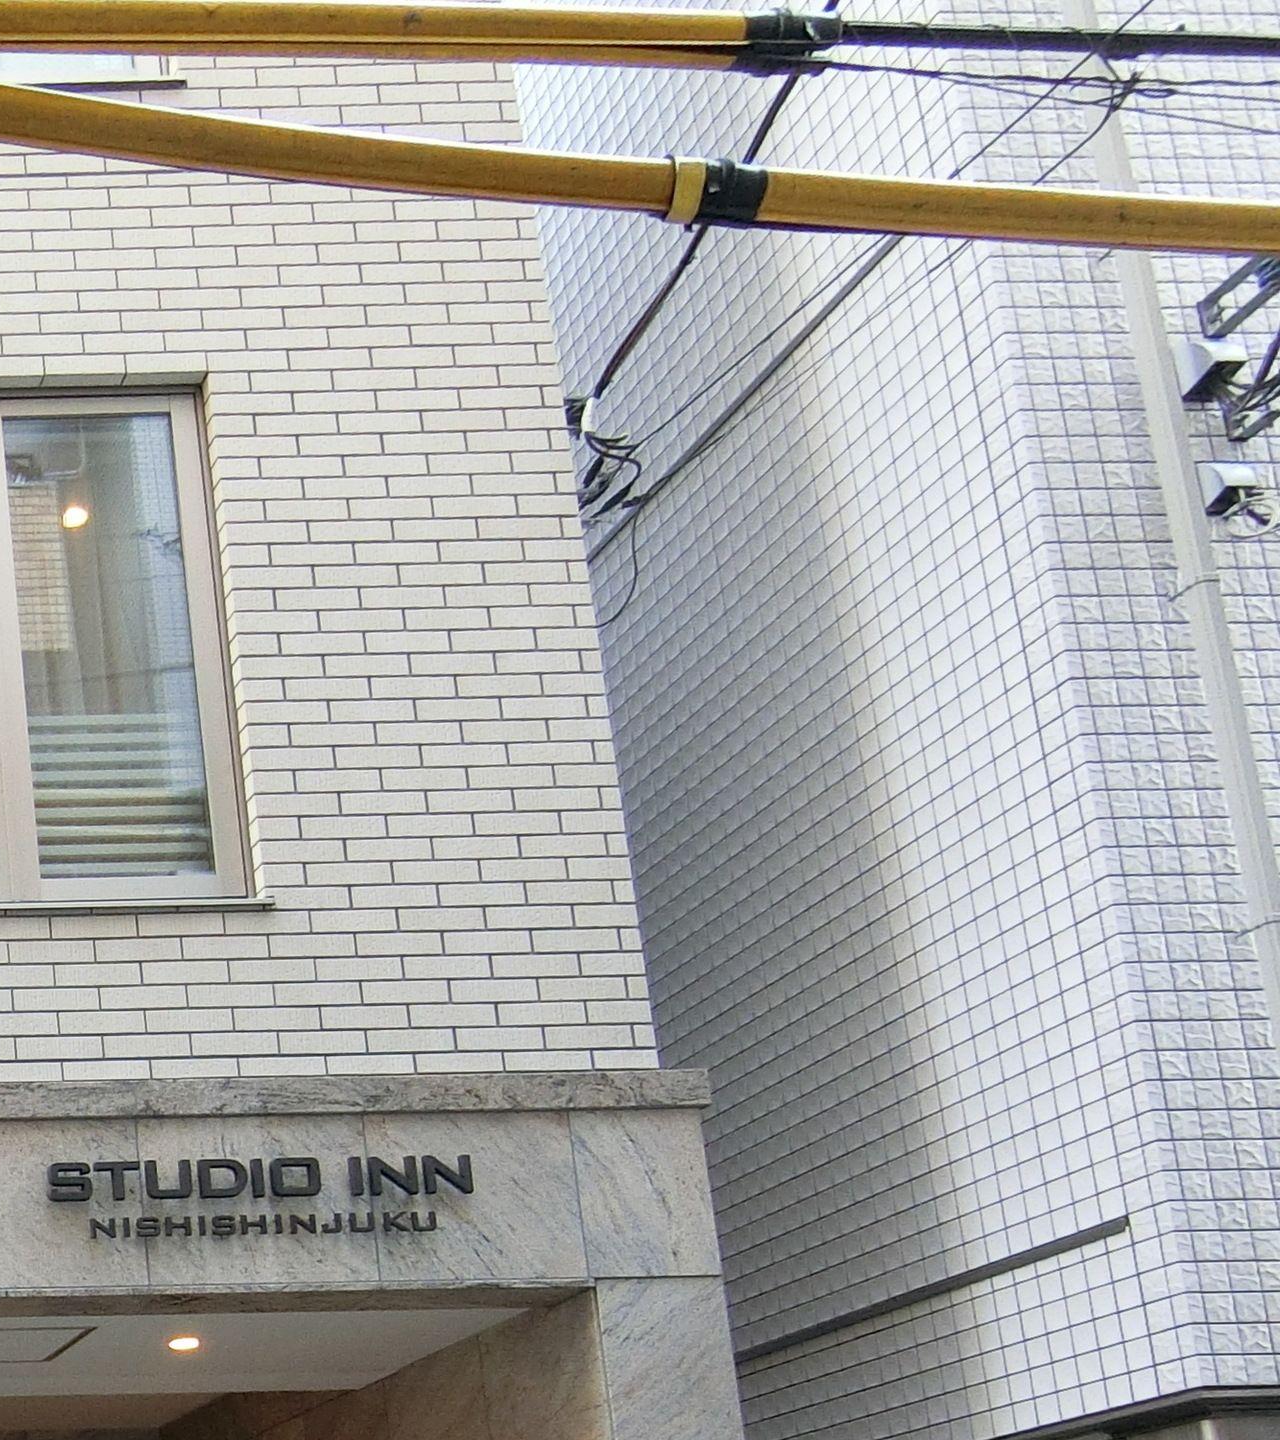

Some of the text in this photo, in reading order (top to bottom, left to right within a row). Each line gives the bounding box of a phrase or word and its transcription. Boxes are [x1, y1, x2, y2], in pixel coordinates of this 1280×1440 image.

[46, 1153, 474, 1202] STUDIO INN
[89, 1209, 439, 1239] NISHISHINJUKU
